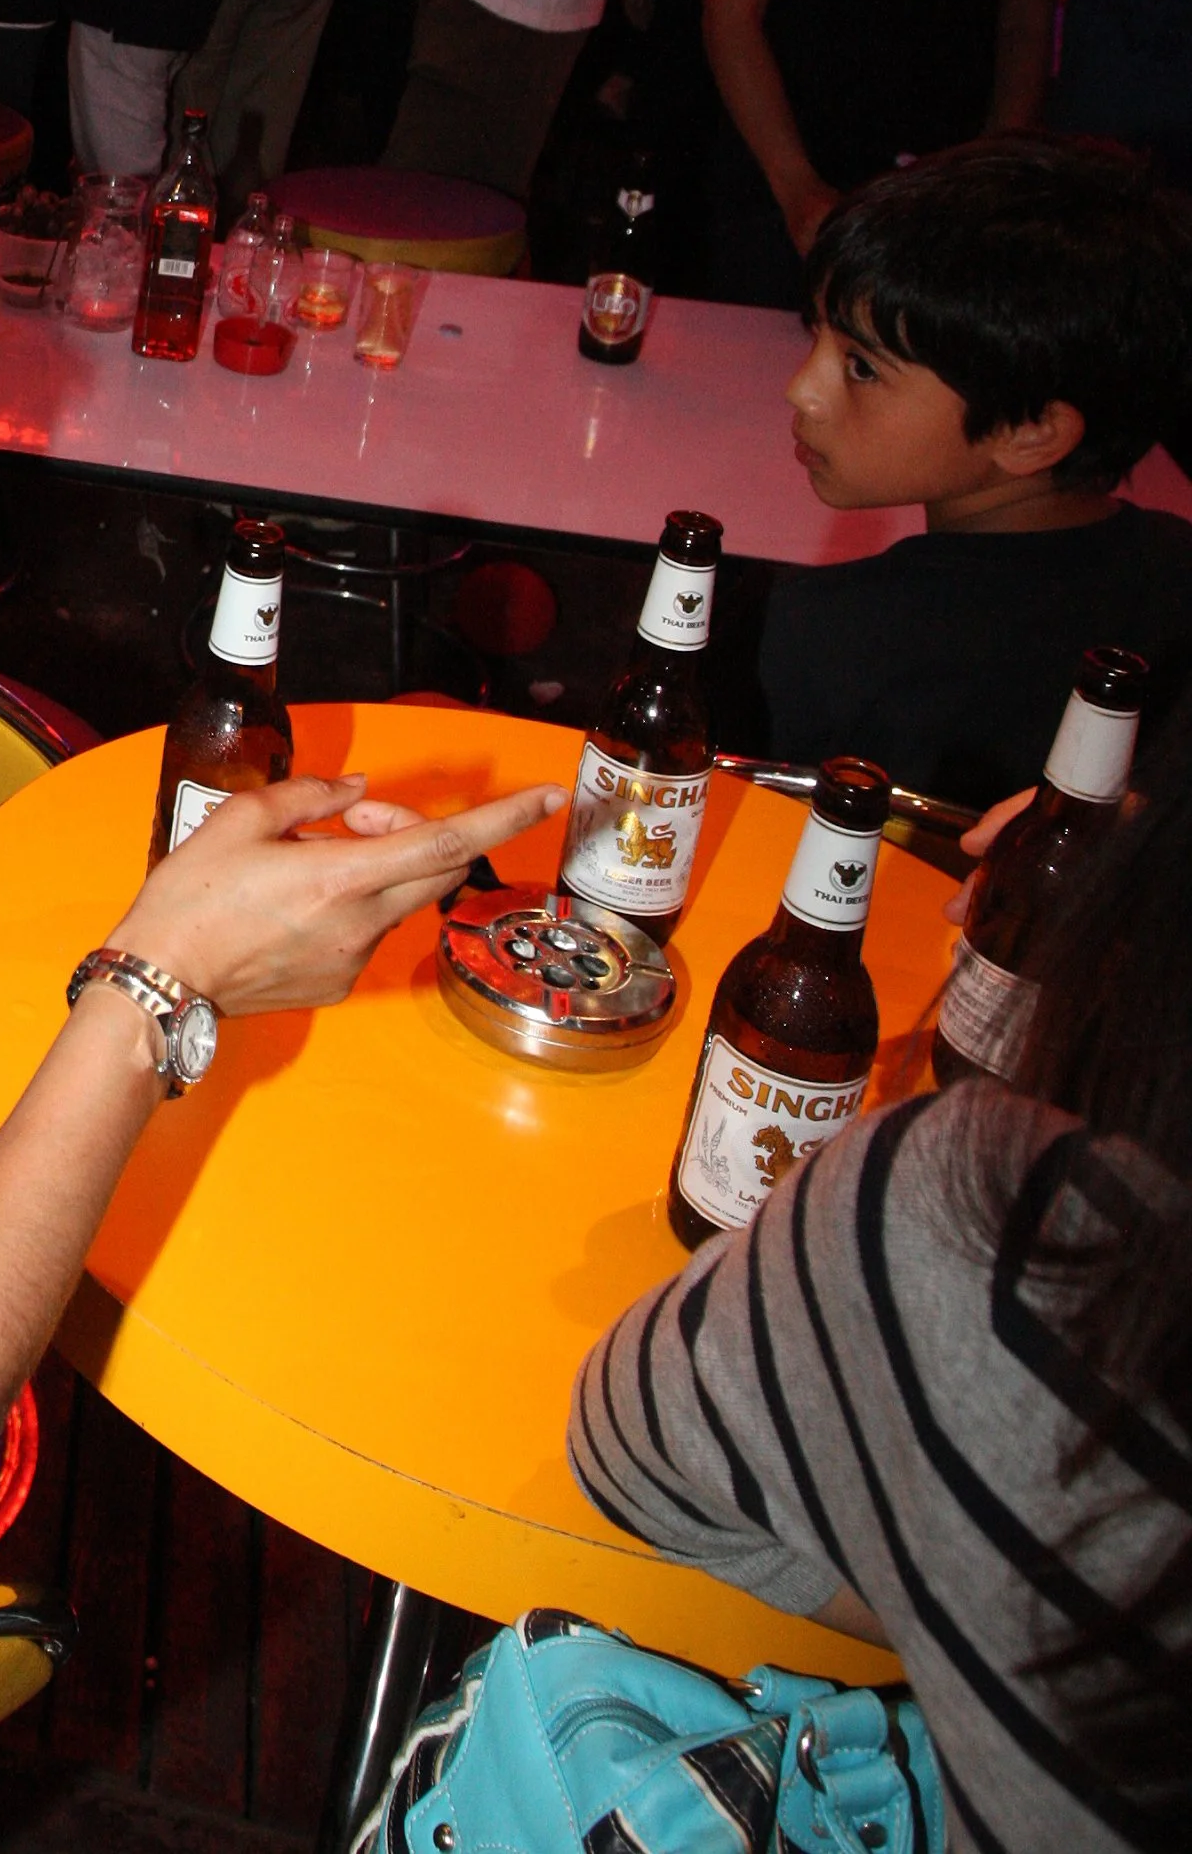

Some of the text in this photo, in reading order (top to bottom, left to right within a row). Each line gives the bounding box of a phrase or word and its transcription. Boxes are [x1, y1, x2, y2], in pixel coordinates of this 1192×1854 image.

[660, 616, 684, 629] THAI
[645, 877, 672, 887] BEER
[813, 888, 843, 905] THAI
[709, 1081, 748, 1117] PREMIUM
